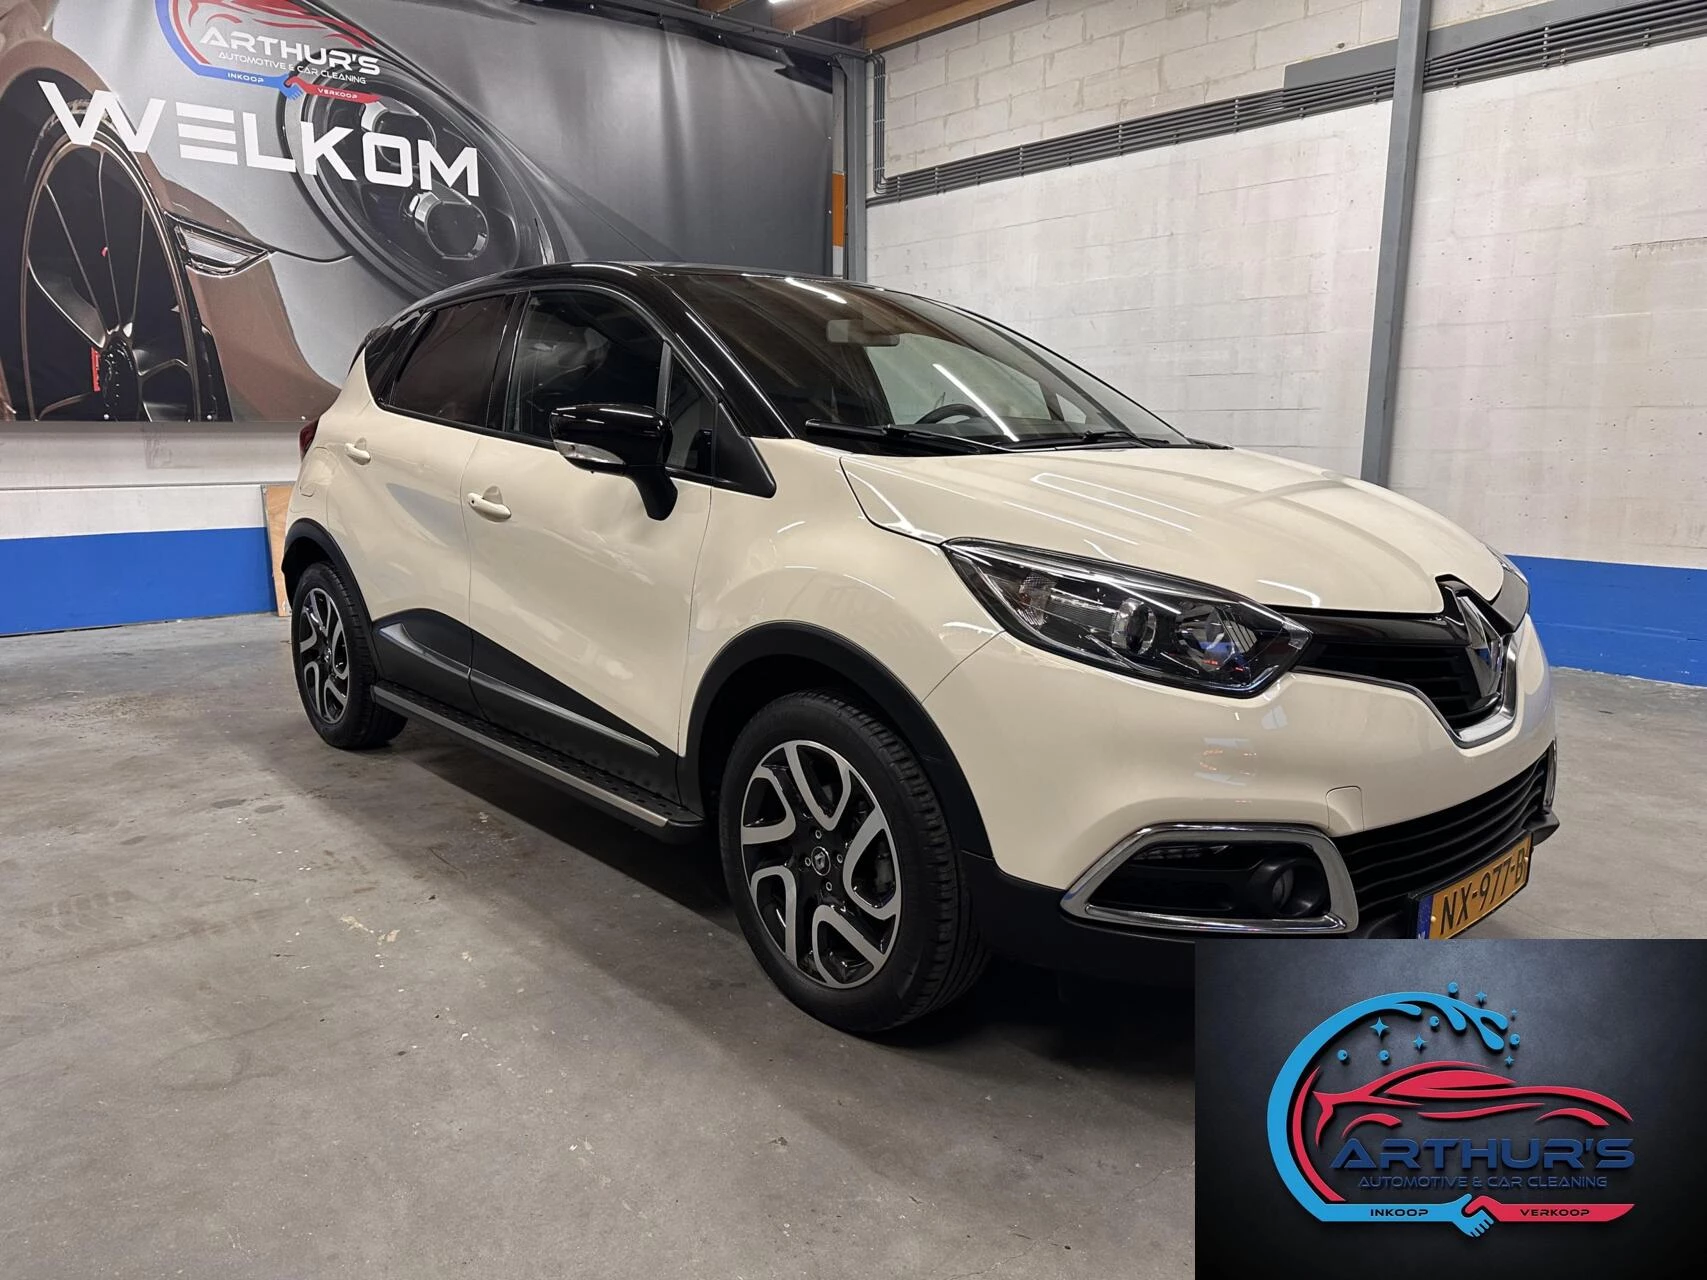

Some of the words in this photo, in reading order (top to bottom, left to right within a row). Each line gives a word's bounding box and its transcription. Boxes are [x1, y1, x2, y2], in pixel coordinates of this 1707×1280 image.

[200, 26, 381, 76] ARTHUR'S
[218, 51, 286, 70] AUTOMOTIVE
[297, 65, 319, 75] CAR
[320, 69, 367, 85] CLEANING
[227, 72, 264, 83] INKOOP
[317, 87, 358, 99] VERKOOP
[38, 80, 480, 197] WELKOM
[1440, 847, 1526, 935] NX-977-B
